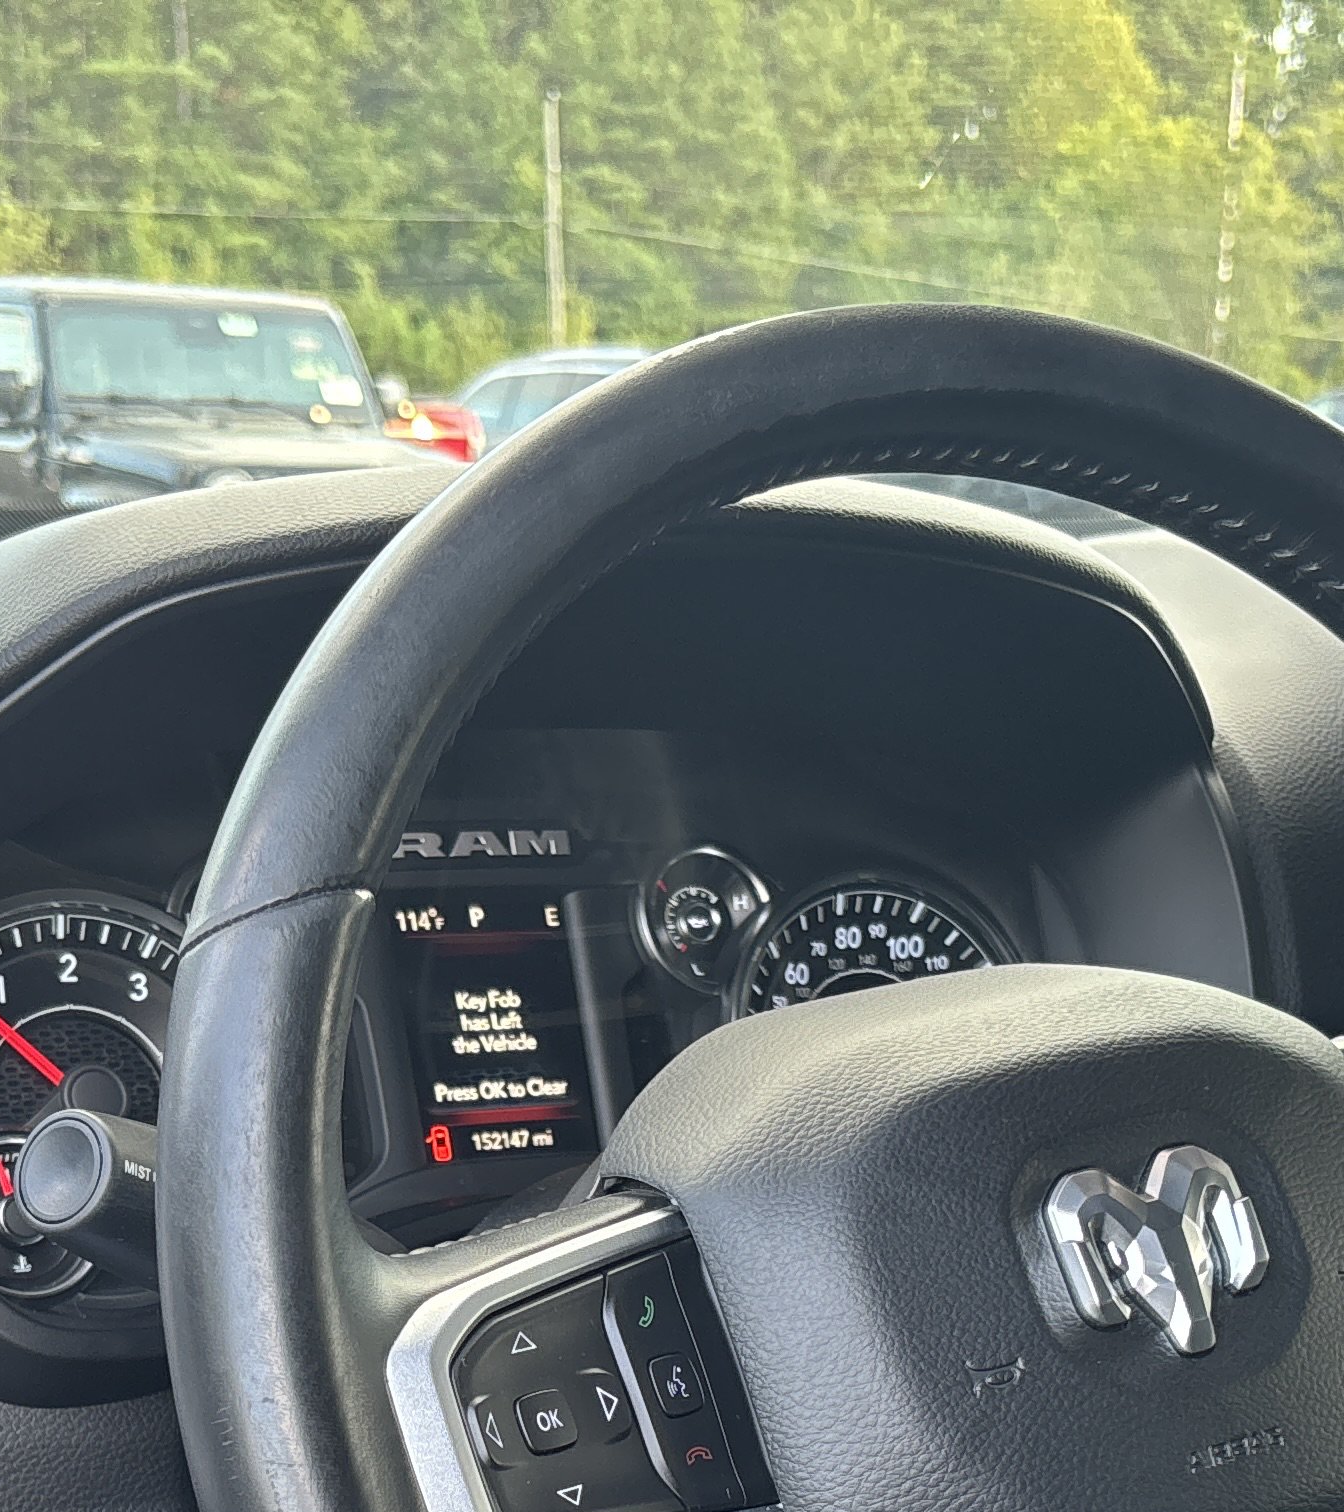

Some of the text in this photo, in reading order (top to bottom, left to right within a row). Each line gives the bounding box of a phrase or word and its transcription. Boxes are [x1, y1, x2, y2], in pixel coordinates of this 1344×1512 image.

[391, 829, 573, 860] RAM
[731, 893, 750, 912] H
[468, 904, 486, 929] P
[543, 904, 561, 928] E
[833, 925, 863, 951] 80
[866, 921, 889, 940] 90
[809, 940, 829, 958] 70
[884, 934, 926, 961] 100
[58, 952, 79, 984] 2
[783, 961, 811, 986] 60
[923, 954, 951, 973] 110
[127, 971, 149, 1002] 3
[454, 989, 522, 1012] Key Fob
[459, 1010, 524, 1032] has Left
[451, 1031, 538, 1054] the Vehicle
[433, 1077, 568, 1103] Press OK to Clear
[471, 1129, 554, 1151] 152147 mi
[123, 1158, 152, 1183] MIST
[535, 1407, 565, 1433] OK
